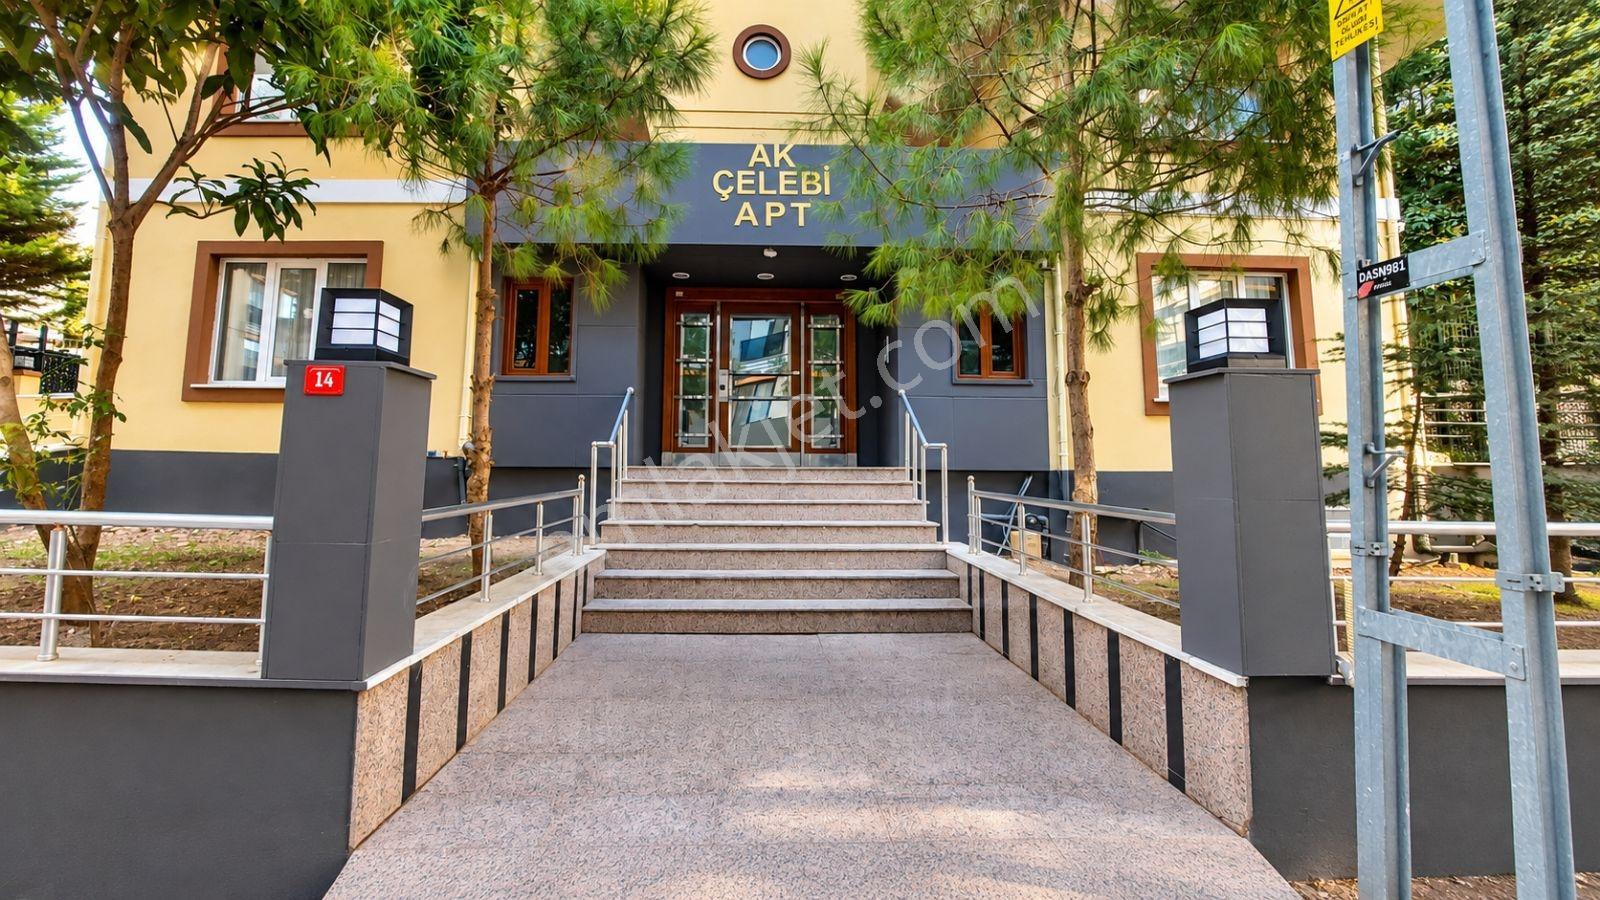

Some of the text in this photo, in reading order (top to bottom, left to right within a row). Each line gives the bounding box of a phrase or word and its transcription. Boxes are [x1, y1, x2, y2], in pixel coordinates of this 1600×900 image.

[748, 143, 796, 168] AK
[712, 165, 831, 202] ÇELEBİ
[734, 202, 811, 227] APT
[315, 371, 334, 388] 14
